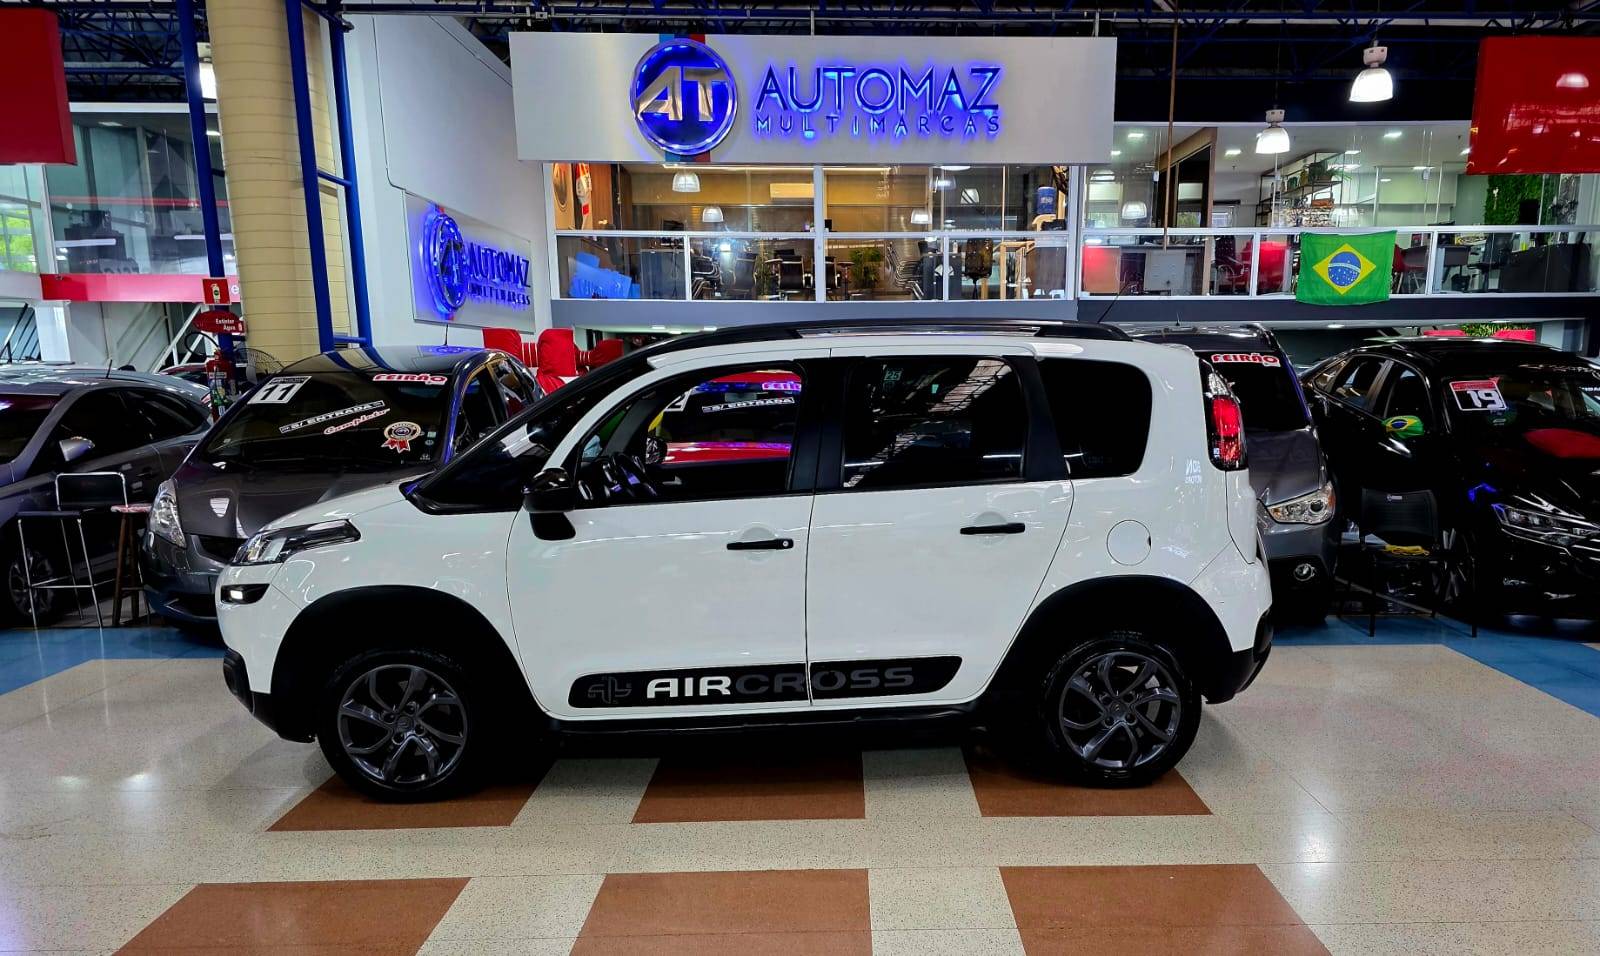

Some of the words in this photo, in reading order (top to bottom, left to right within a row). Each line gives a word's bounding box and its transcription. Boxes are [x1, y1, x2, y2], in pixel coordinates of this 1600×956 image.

[635, 66, 727, 122] AT
[756, 64, 1001, 113] AUTOMAZ
[756, 115, 1000, 135] MULTIMARCAS
[468, 241, 531, 289] AUTOMAZ
[1211, 353, 1279, 364] FEIRÃO
[373, 373, 447, 382] FEIRÃO
[260, 384, 296, 400] 11
[1467, 388, 1503, 410] 19
[728, 397, 791, 409] ENTRADA
[307, 404, 376, 424] ENTRADA
[647, 667, 914, 699] AIRCROSS
